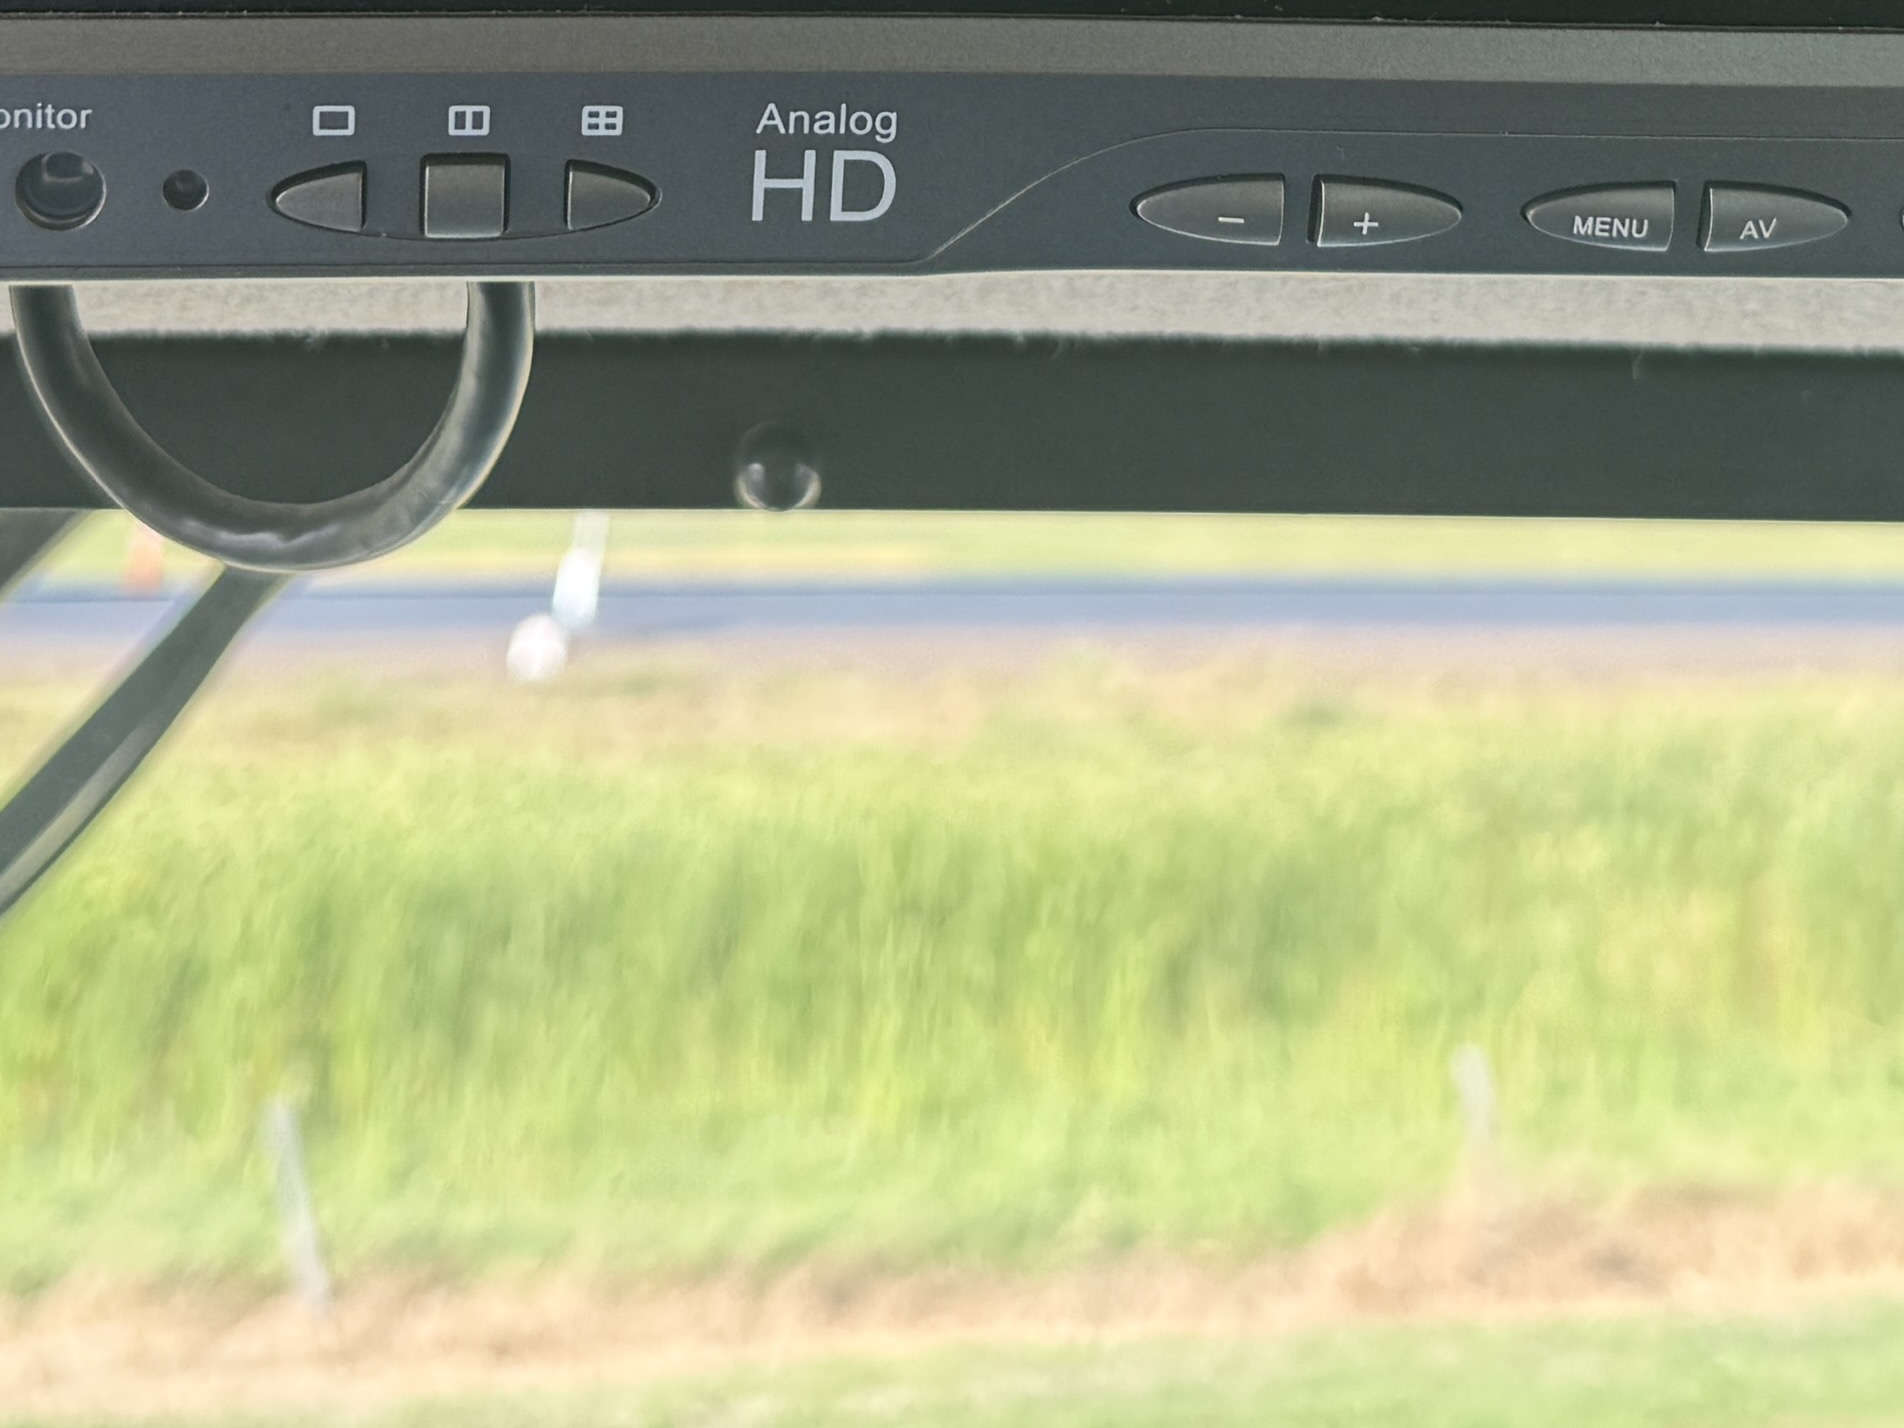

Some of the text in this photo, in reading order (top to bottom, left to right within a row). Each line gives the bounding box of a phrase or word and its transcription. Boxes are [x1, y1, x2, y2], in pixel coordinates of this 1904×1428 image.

[755, 102, 898, 144] Analog
[751, 149, 898, 223] HD
[1572, 214, 1650, 239] MENU
[1738, 216, 1778, 241] AV
